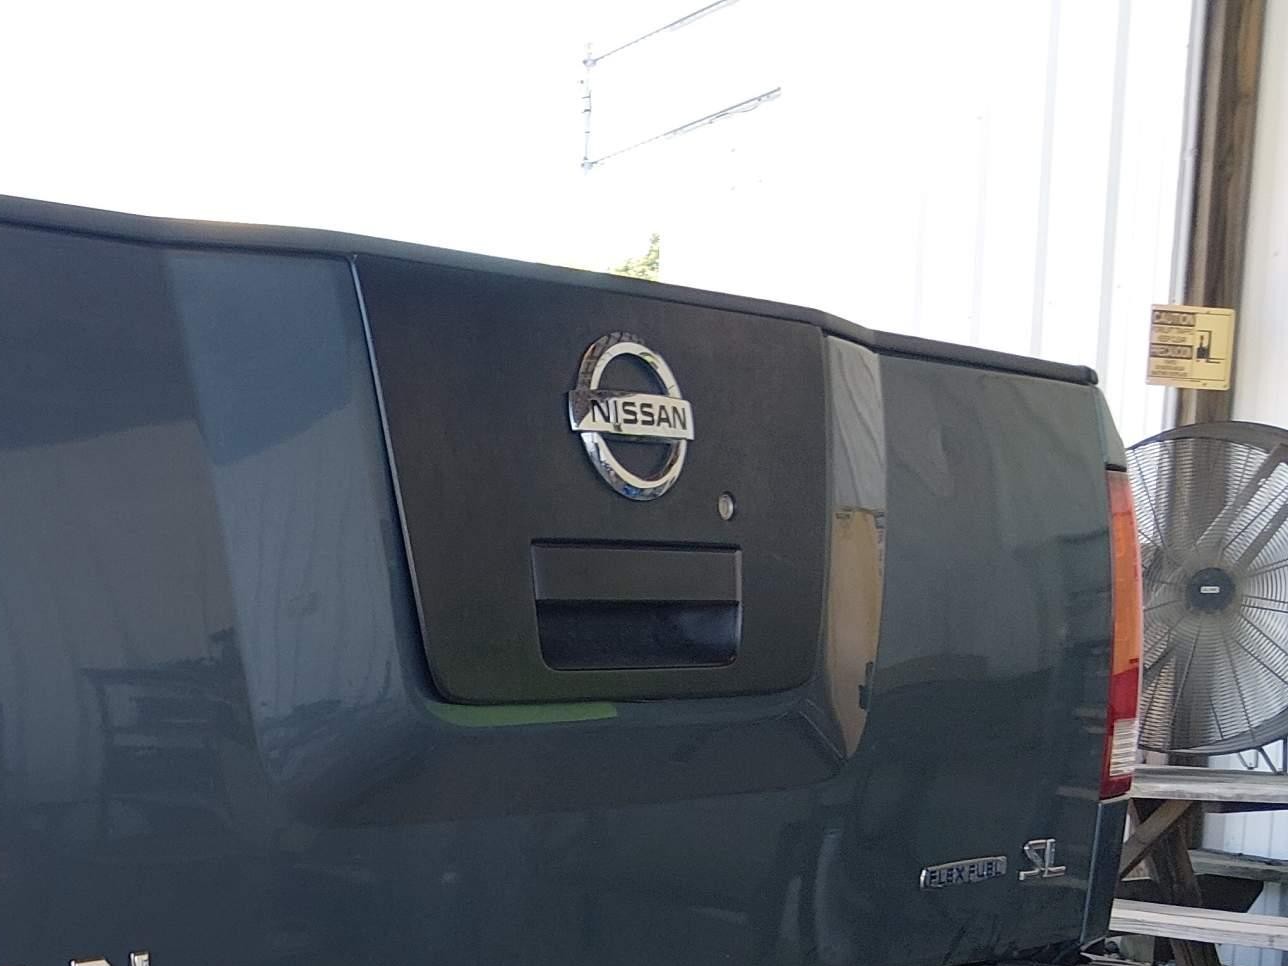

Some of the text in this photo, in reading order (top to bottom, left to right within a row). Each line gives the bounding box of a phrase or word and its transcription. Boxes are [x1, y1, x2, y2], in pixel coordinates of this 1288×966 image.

[591, 399, 688, 430] NISSAN
[930, 861, 1003, 885] FLEX FUEL
[1018, 838, 1066, 881] SL
